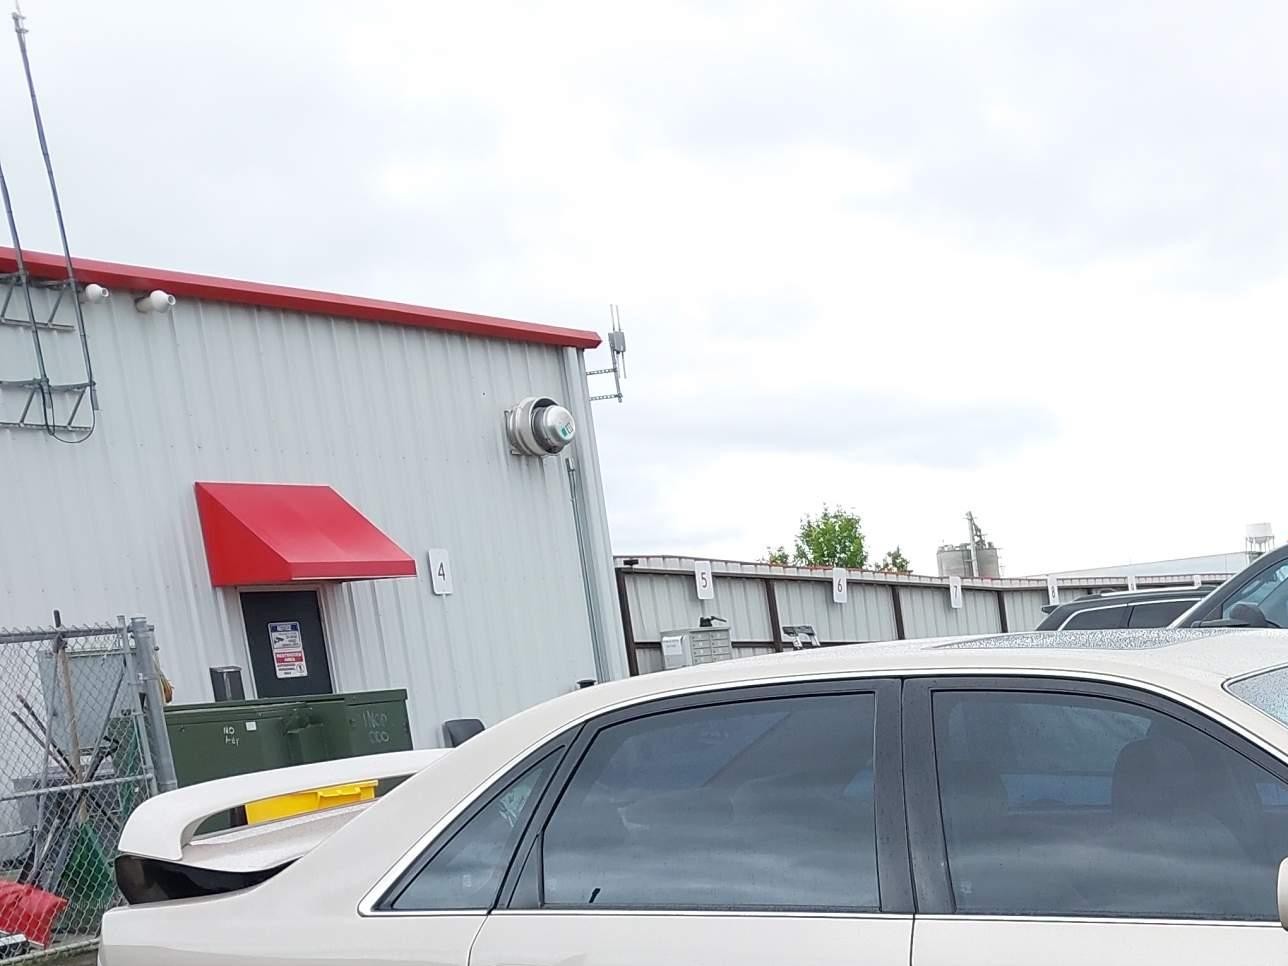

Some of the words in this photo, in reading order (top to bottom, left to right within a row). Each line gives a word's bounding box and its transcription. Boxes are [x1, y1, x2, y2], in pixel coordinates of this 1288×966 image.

[437, 561, 446, 581] 4
[700, 571, 708, 588] 5
[837, 577, 843, 592] 6
[952, 585, 959, 598] 7
